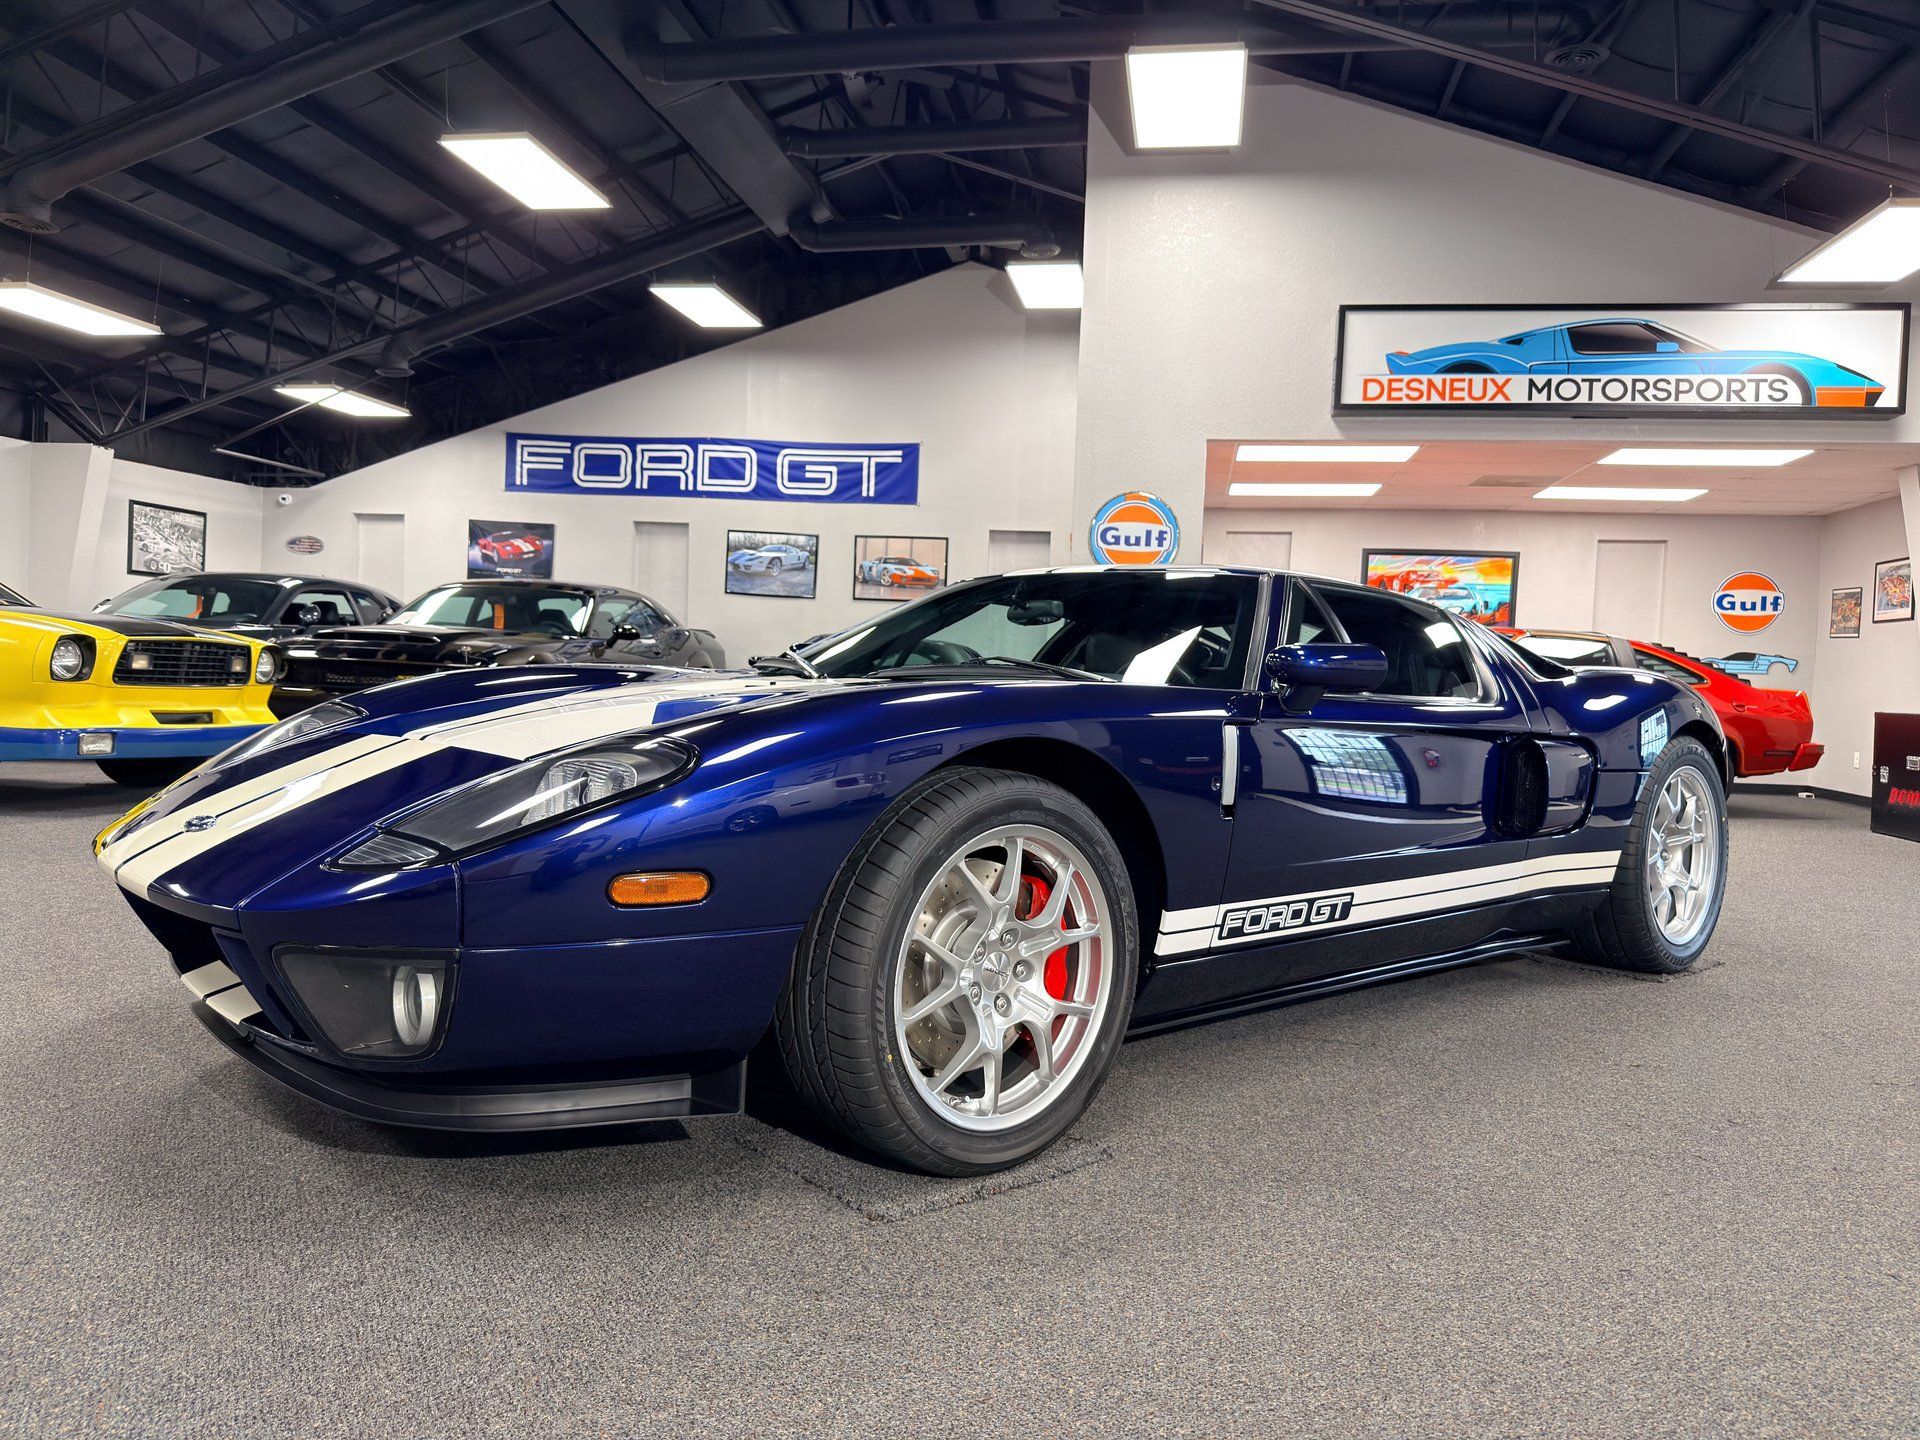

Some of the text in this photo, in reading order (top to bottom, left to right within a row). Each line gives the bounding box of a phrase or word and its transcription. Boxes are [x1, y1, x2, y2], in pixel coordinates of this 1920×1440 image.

[1361, 377, 1789, 403] DESNEUX MOTORSPORTS
[515, 439, 903, 498] FORD GT
[1100, 526, 1168, 547] Gulf
[1715, 593, 1782, 612] Gulf
[1222, 896, 1351, 937] FORD GT
